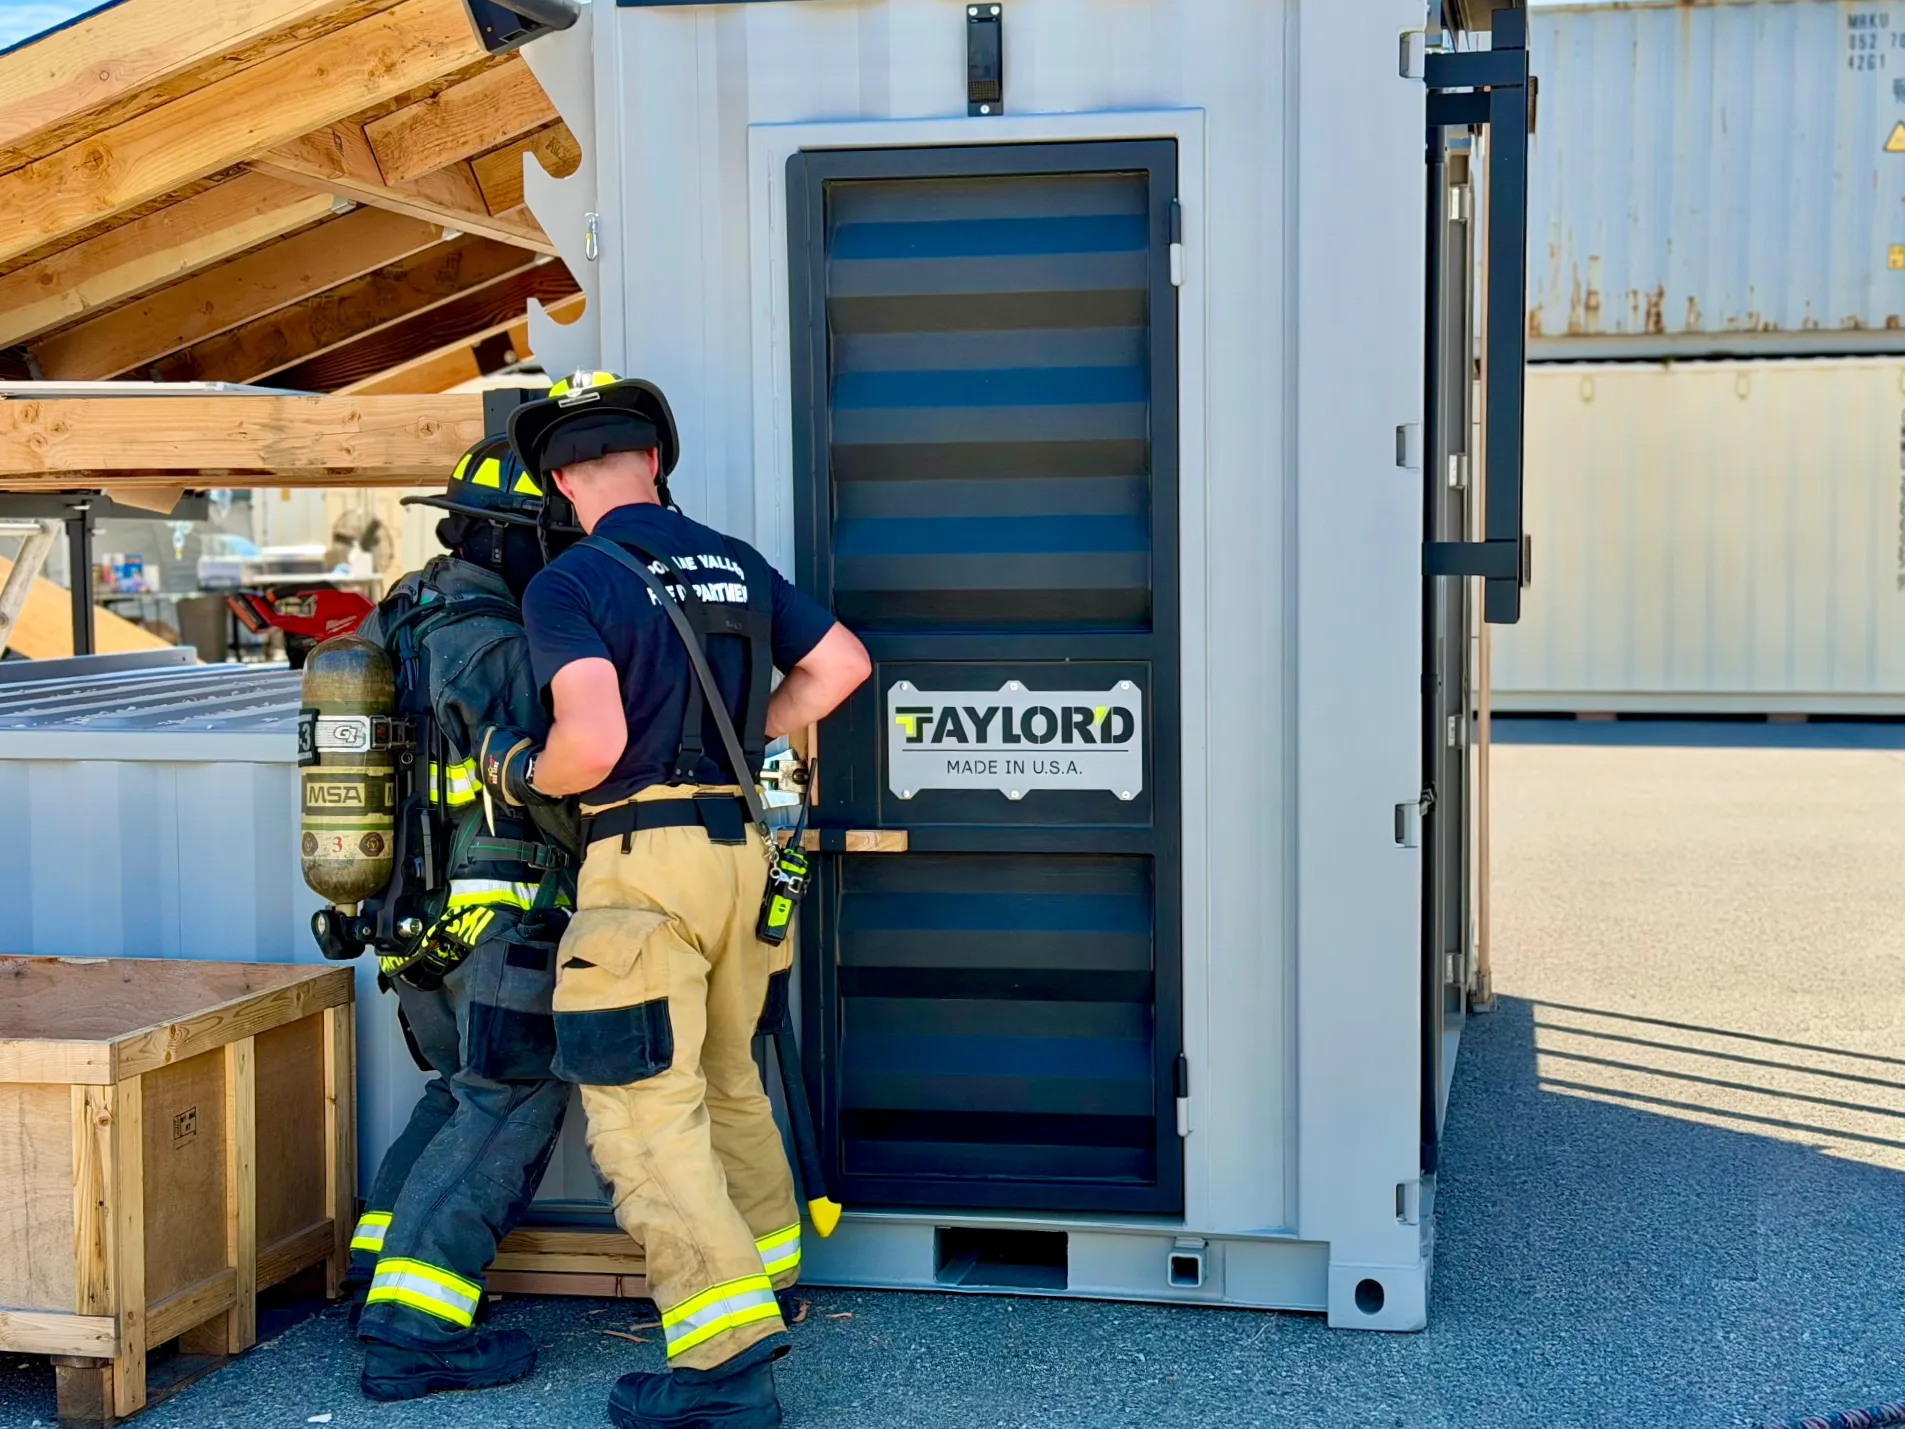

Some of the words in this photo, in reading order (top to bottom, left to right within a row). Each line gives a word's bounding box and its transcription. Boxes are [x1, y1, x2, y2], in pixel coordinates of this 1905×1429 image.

[947, 760, 998, 775] MADE
[1005, 760, 1025, 775] IN
[1033, 760, 1083, 775] U.S.A.
[309, 786, 363, 804] MSA
[332, 836, 343, 853] 3
